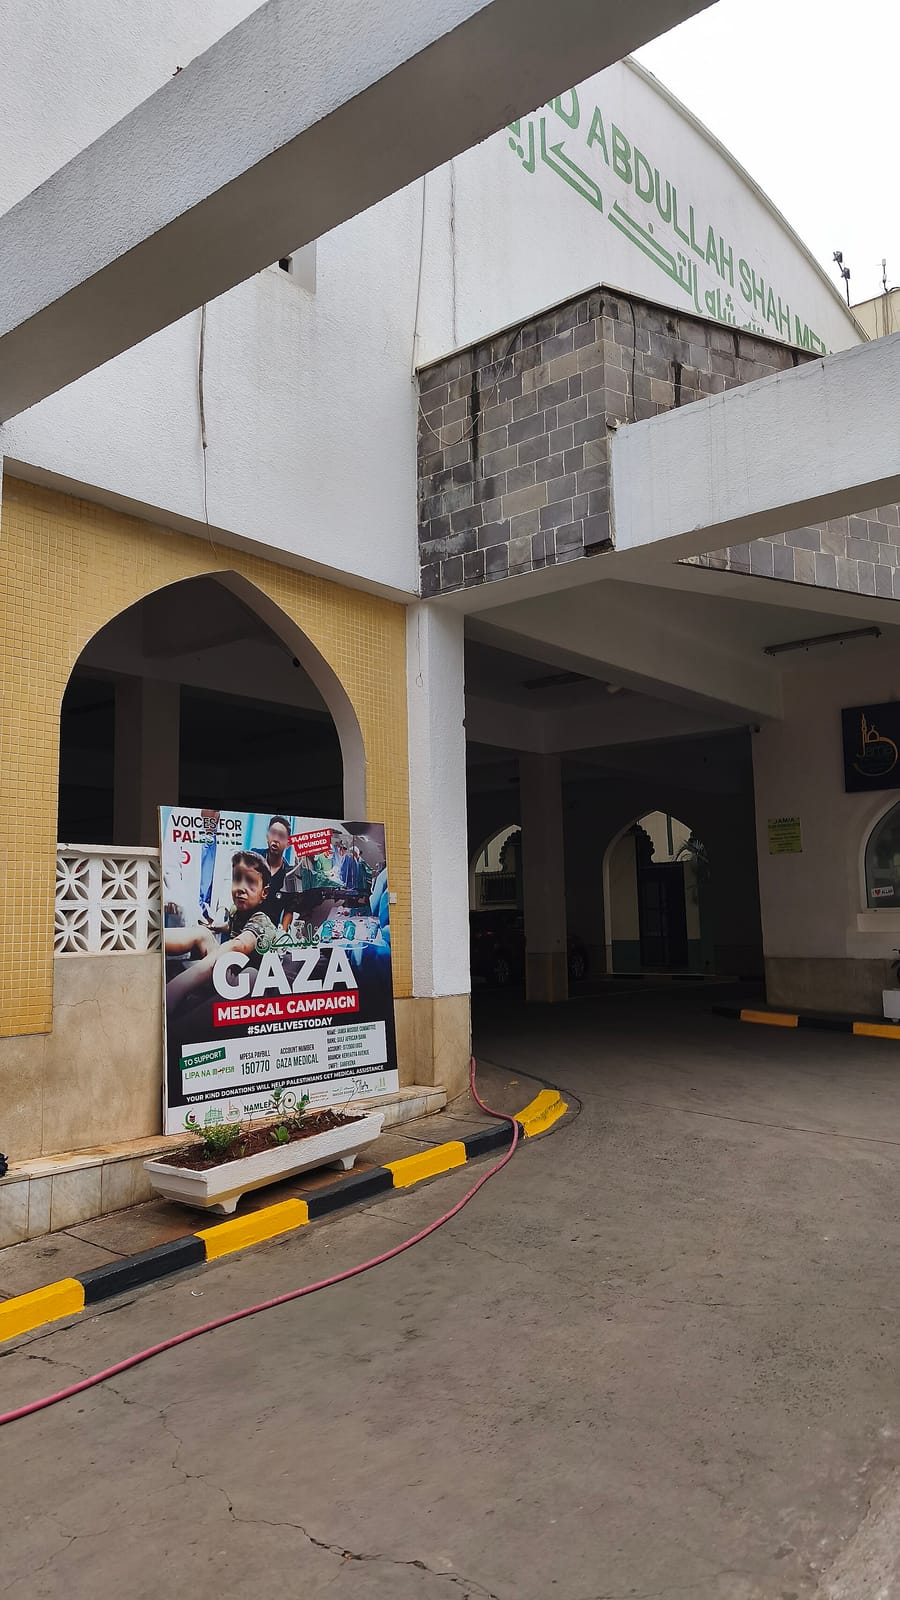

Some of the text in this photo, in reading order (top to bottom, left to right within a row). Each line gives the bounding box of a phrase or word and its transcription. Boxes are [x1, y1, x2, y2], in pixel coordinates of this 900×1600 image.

[585, 105, 735, 289] ABDULLAH
[738, 258, 792, 343] SHAH
[171, 815, 242, 831] VOICES FOR
[172, 829, 242, 845] PALESTINE
[309, 830, 331, 840] PEOPLE
[297, 838, 328, 849] WOUNDED
[212, 948, 359, 1000] GAZA
[217, 995, 356, 1021] MEDICAL CAMPAIGN
[247, 1017, 333, 1035] #SAVELIVESTODAY
[239, 1050, 271, 1060] MPESA PAYBILL
[280, 1043, 315, 1055] ACCOUNT NUMBER
[183, 1050, 222, 1067] TO SUPPORT
[275, 1053, 319, 1069] GAZA MEDICAL
[184, 1071, 200, 1080] LIPA
[201, 1069, 211, 1078] NA
[241, 1059, 270, 1076] 150770
[186, 1095, 204, 1103] YOUR
[204, 1092, 220, 1100] KIND
[221, 1085, 256, 1097] DONATIONS
[255, 1082, 271, 1091] WILL
[271, 1080, 286, 1089] HELP
[286, 1074, 323, 1086] PALESTINIANS
[323, 1072, 333, 1080] GET
[333, 1069, 355, 1078] MEDICAL
[354, 1064, 384, 1076] ASSISTANCE
